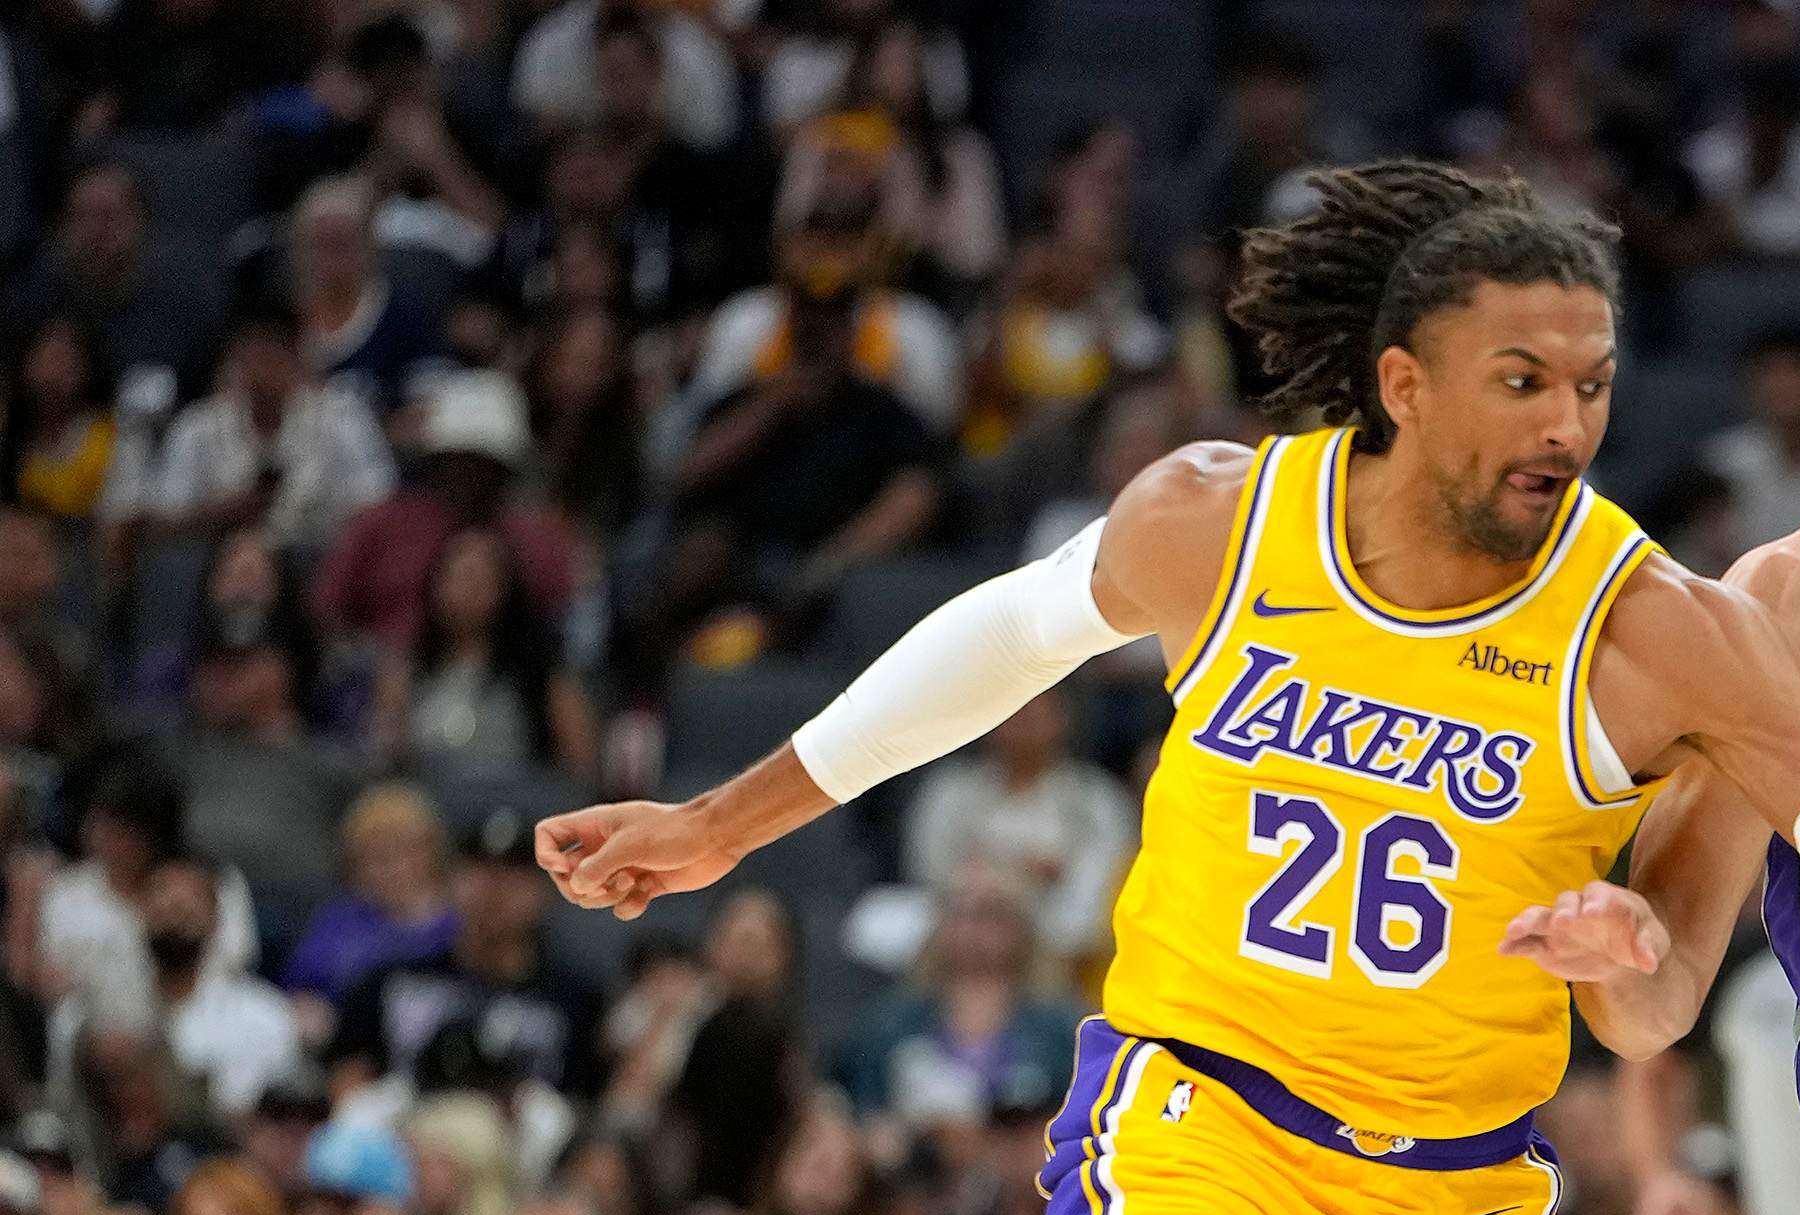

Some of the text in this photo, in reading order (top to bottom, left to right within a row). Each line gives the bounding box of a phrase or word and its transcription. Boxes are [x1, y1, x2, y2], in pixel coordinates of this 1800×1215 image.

[1193, 642, 1535, 824] LAKERS
[1457, 641, 1554, 686] Albert
[1239, 788, 1461, 989] 26
